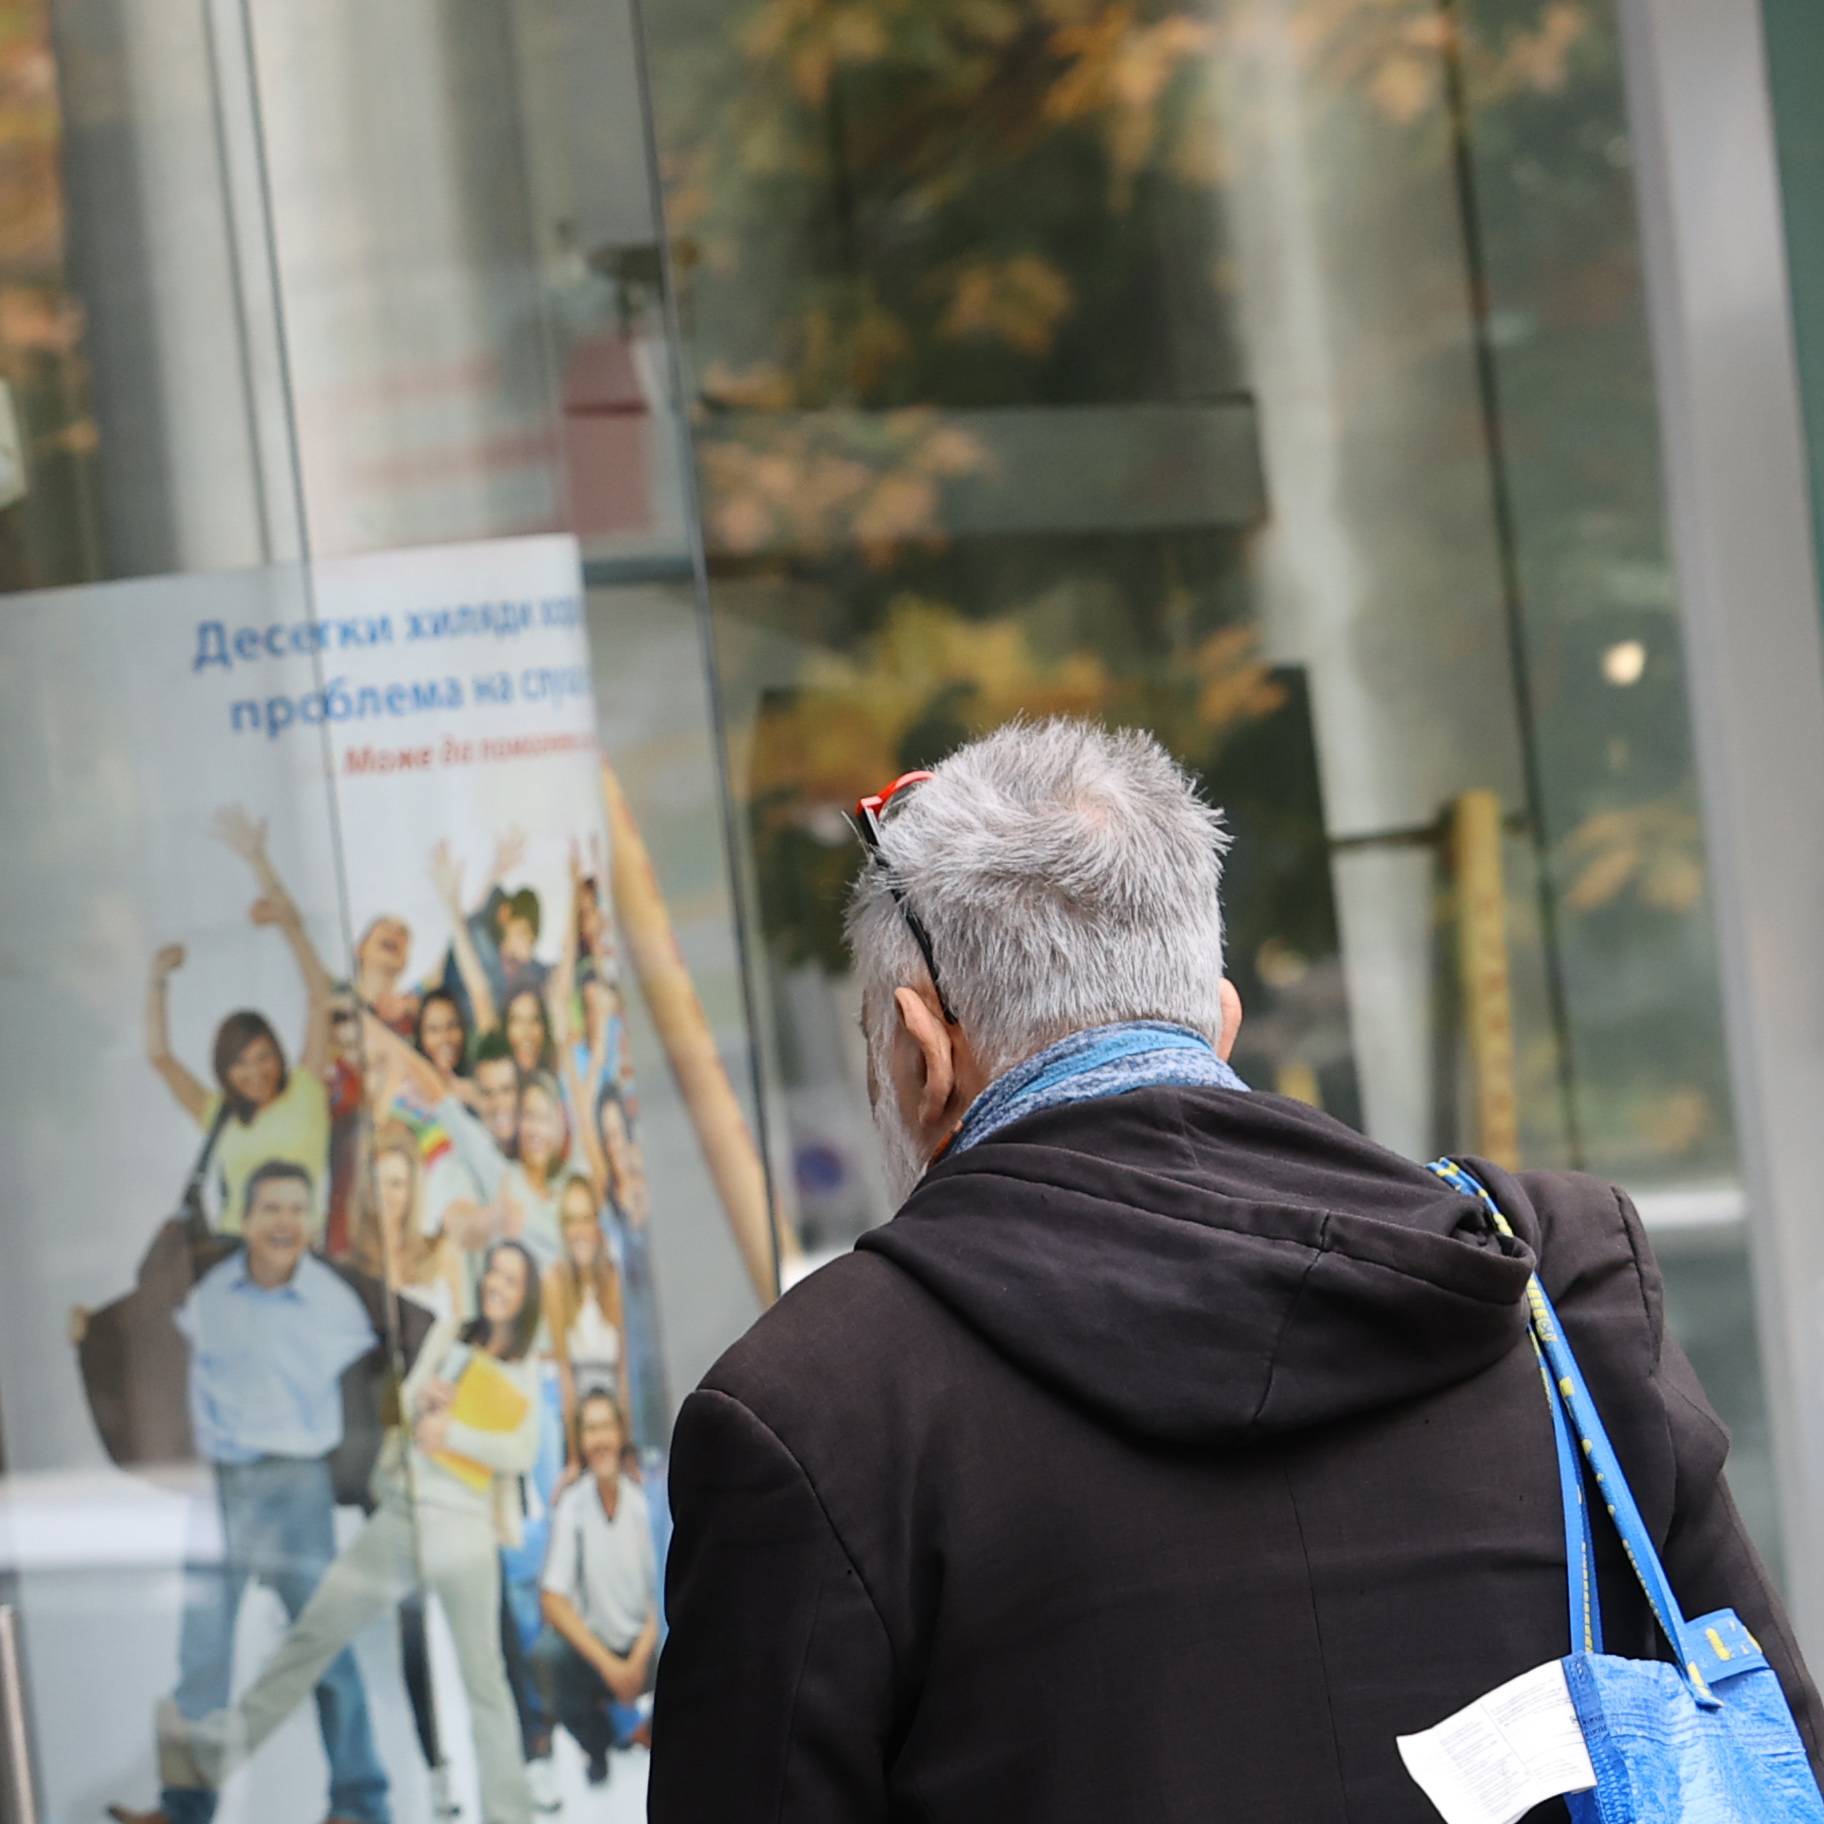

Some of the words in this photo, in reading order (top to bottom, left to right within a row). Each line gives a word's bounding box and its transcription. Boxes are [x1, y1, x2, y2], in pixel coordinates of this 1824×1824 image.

[192, 612, 393, 672] Десетки
[231, 674, 463, 738] проблема
[471, 671, 513, 704] на
